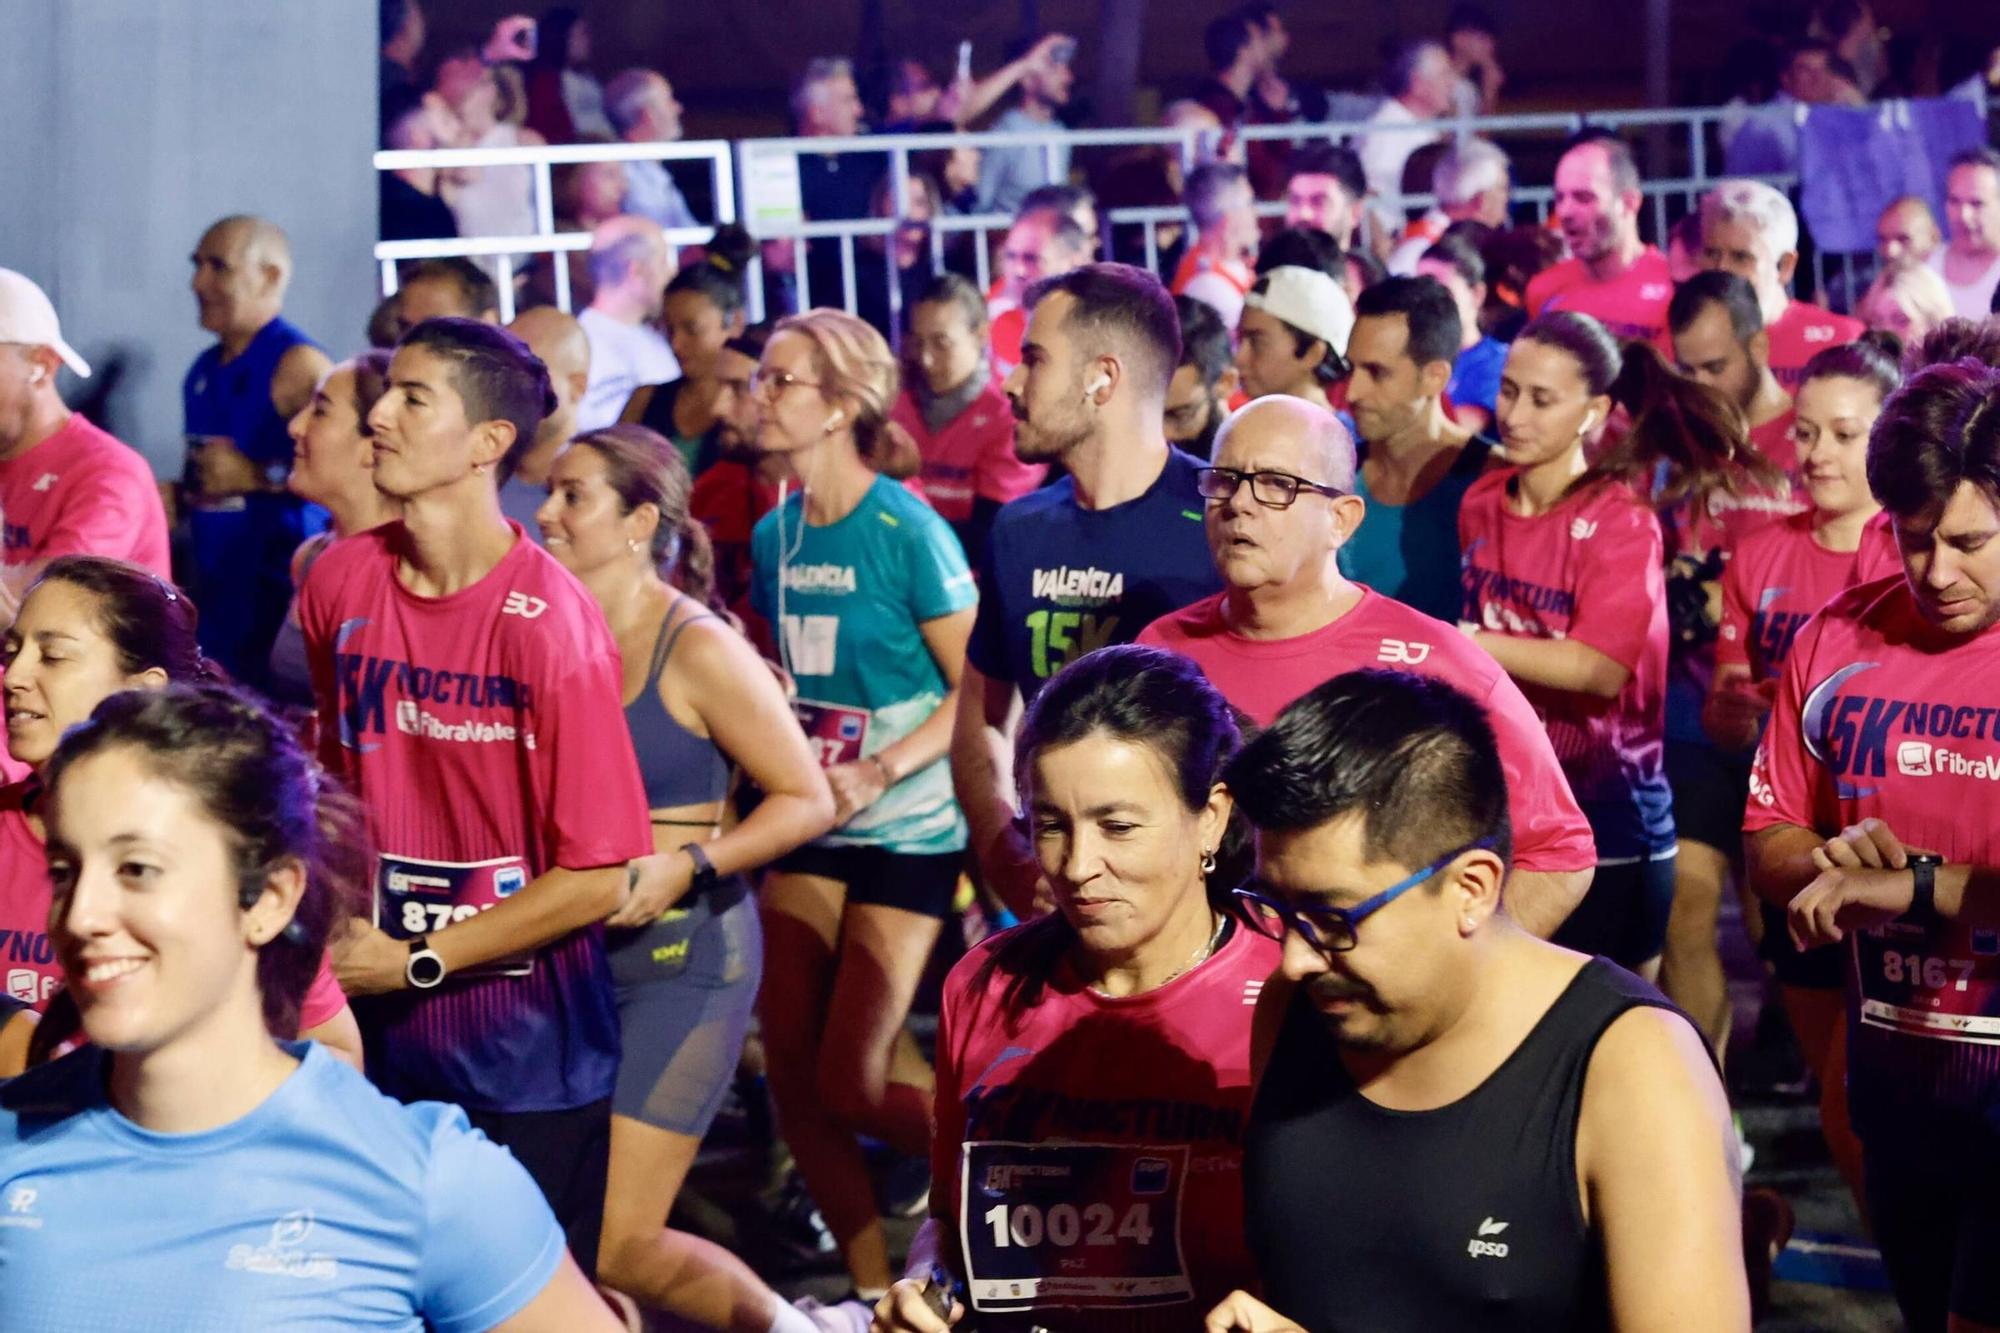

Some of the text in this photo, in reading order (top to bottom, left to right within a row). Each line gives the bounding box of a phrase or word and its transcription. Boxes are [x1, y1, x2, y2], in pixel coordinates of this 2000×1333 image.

[1032, 565, 1123, 601] VALENCIA
[1883, 950, 1976, 991] 8167
[984, 1203, 1154, 1248] 10024
